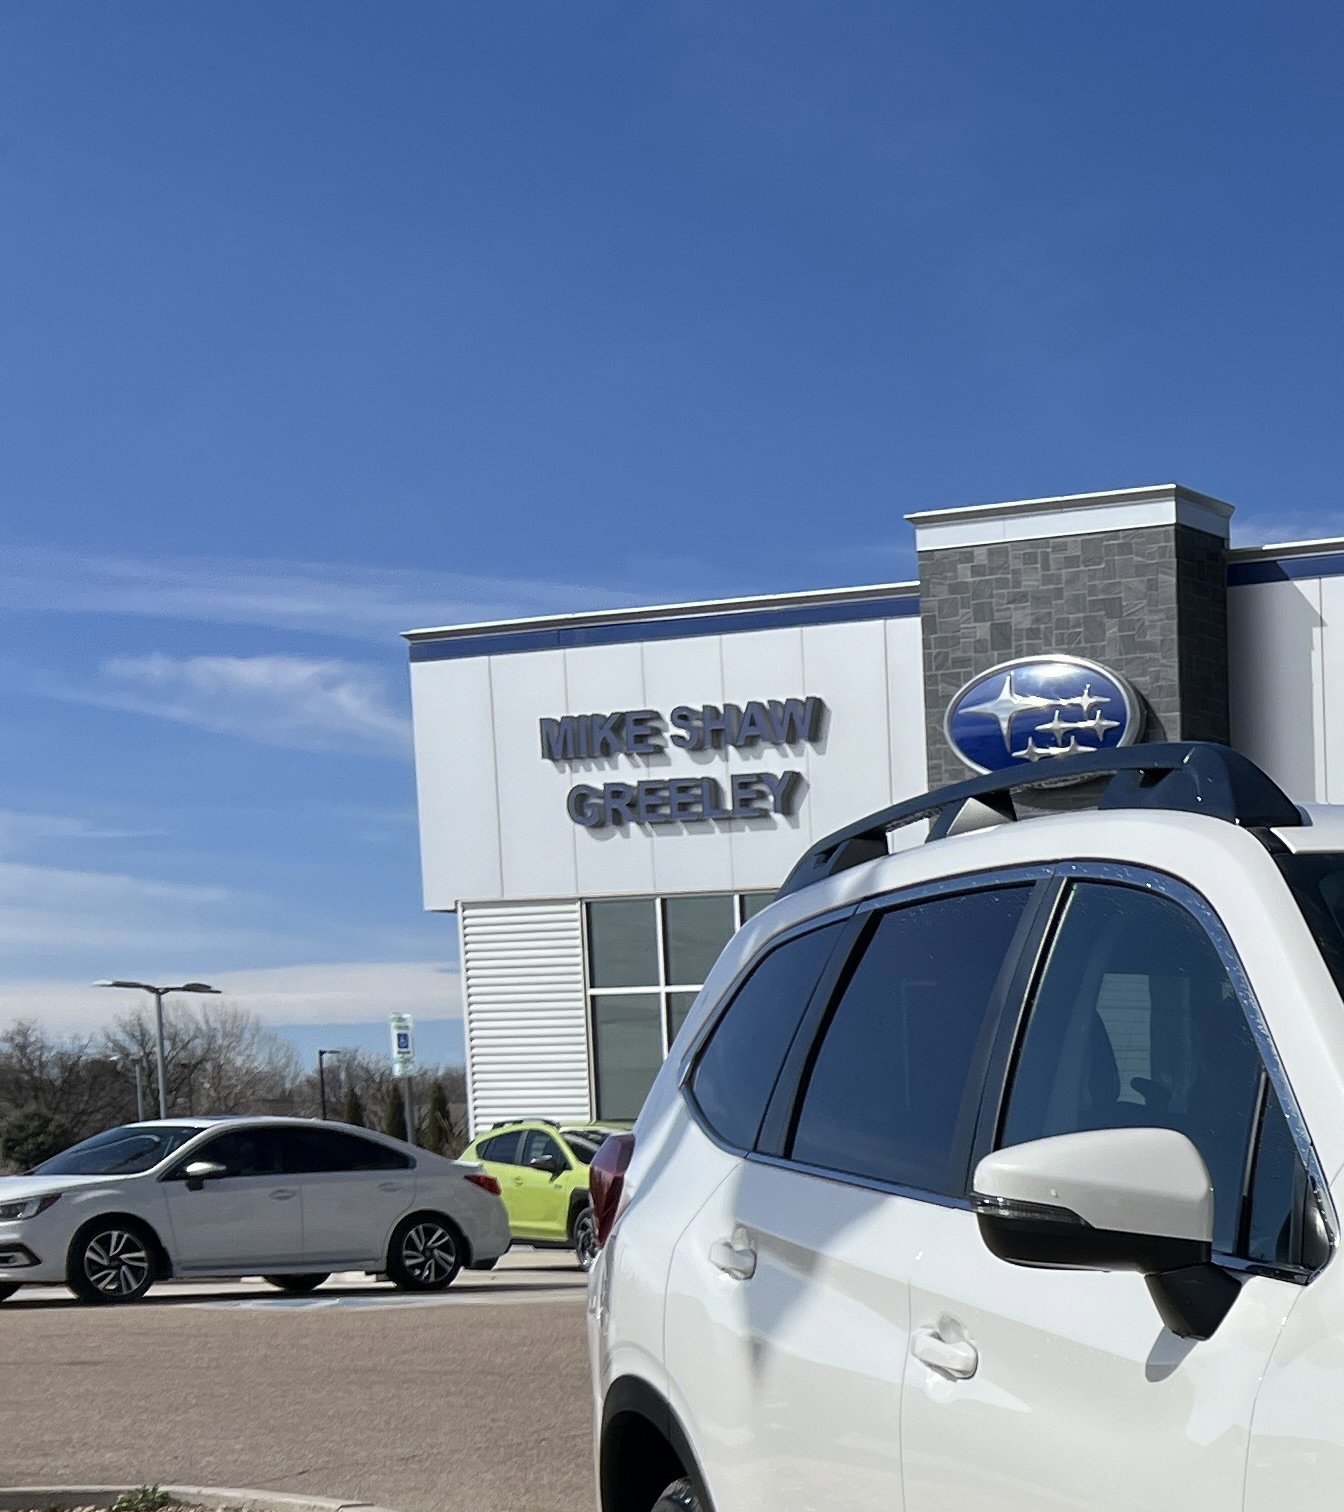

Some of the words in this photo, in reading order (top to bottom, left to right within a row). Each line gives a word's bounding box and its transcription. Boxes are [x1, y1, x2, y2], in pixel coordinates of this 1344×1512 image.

[540, 709, 666, 760] MIKE
[670, 696, 824, 750] SHAW
[567, 770, 802, 827] GREELEY
